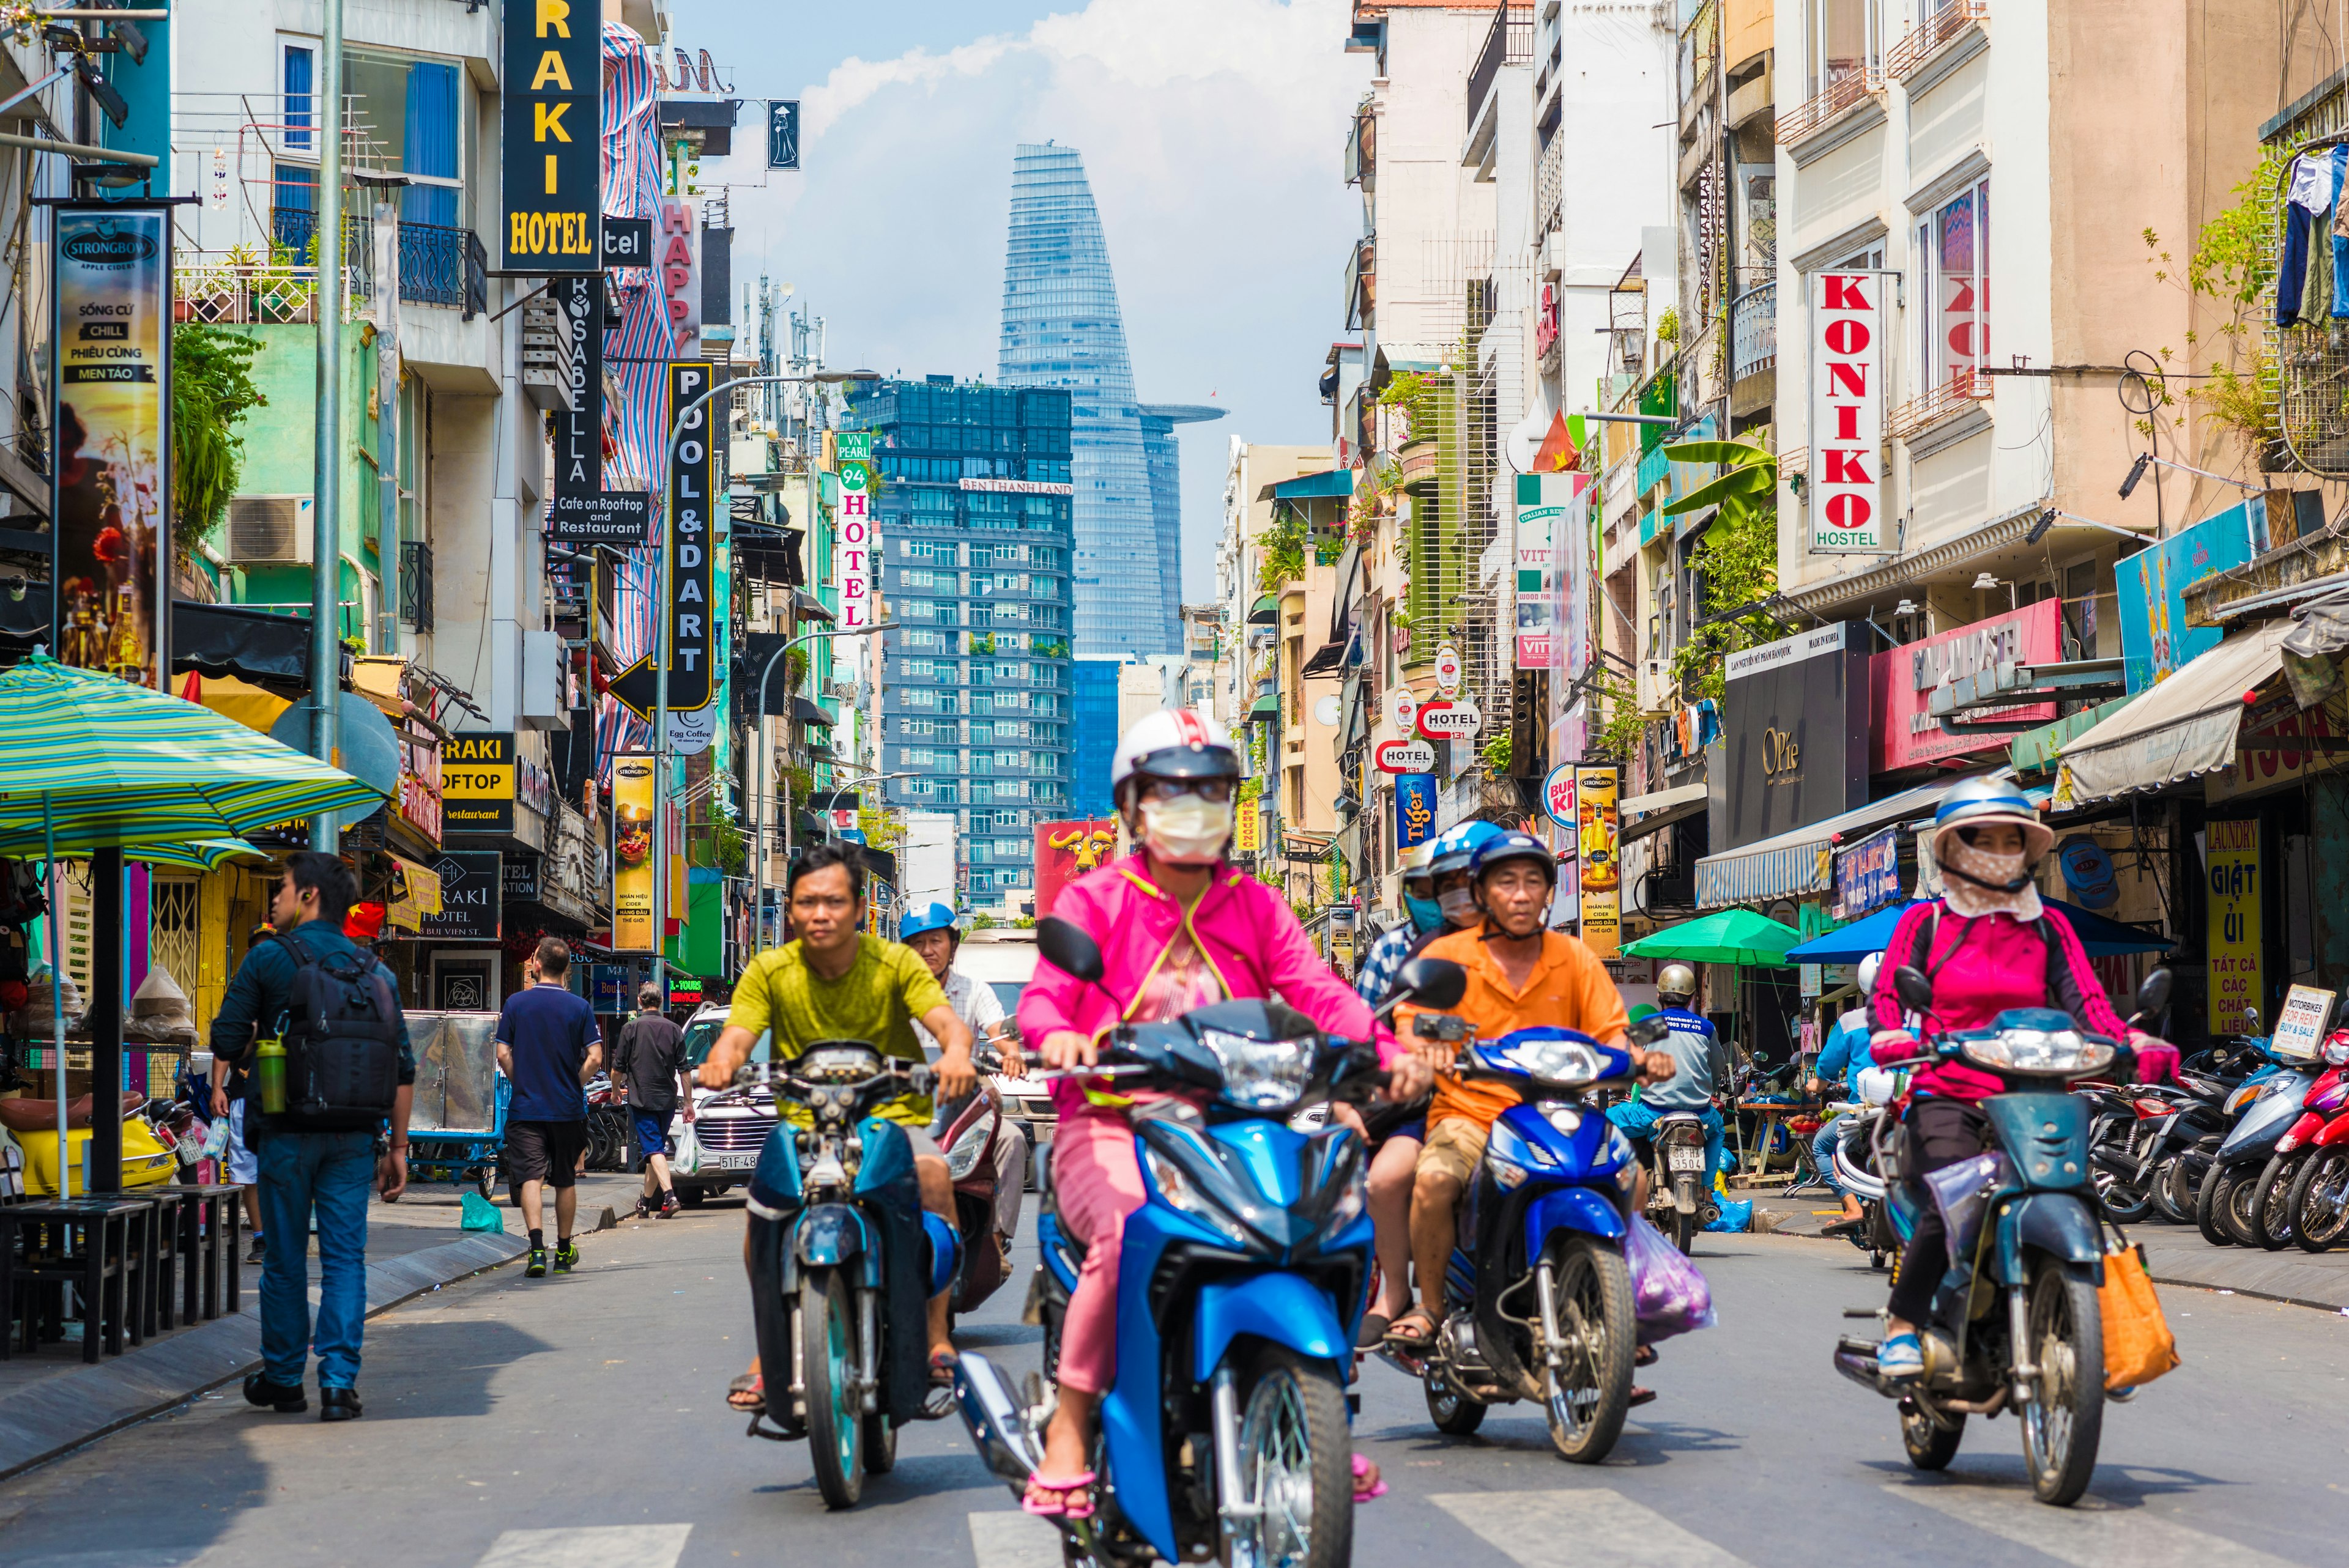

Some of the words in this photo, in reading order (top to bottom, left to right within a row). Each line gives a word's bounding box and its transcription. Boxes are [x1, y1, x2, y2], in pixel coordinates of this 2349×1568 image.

[510, 212, 592, 255] HOTEL
[71, 243, 148, 254] STRONGBOW
[79, 302, 113, 316] SỐNG
[116, 303, 135, 316] CỨ
[90, 326, 123, 336] CHILL
[71, 346, 104, 359] PHIÊU
[106, 345, 141, 358] CÙNG
[79, 369, 106, 379] MEN
[108, 366, 133, 379] TÁO
[1820, 275, 1875, 528] KONIKO
[847, 435, 861, 445] VN
[839, 447, 869, 457] PEARL
[843, 469, 865, 484] 94
[963, 479, 987, 490] BEN
[989, 481, 1034, 493] THANH
[1039, 483, 1072, 495] LAND
[559, 497, 583, 510] Cafe
[585, 500, 598, 510] on
[599, 497, 643, 514] Rooftop
[590, 512, 611, 522] and
[1521, 509, 1548, 522] ITALIAN
[559, 522, 642, 534] Restaurant
[1817, 532, 1877, 545] HOSTEL
[844, 495, 866, 626] HOTEL
[1809, 638, 1820, 649] MADE
[1820, 636, 1825, 645] IN
[1825, 632, 1839, 645] KOREA
[1429, 714, 1477, 724] HOTEL
[1387, 752, 1430, 760] HOTEL
[1553, 792, 1573, 815] KI
[447, 809, 499, 819] restaurant
[1405, 790, 1431, 841] Tiger
[2208, 820, 2258, 852] LAUNDRY
[2080, 862, 2093, 870] 333
[2211, 859, 2257, 903] GIẶT
[2212, 953, 2236, 972] TẤT
[2240, 953, 2257, 972] CẢ
[2222, 974, 2247, 992] CÁC
[2288, 999, 2323, 1013] MOTORBIKES
[2284, 1009, 2298, 1022] FOR
[2299, 1011, 2319, 1027] RENT
[2280, 1022, 2293, 1034] BUY
[2293, 1025, 2298, 1034] &
[2298, 1026, 2315, 1037] SALE
[722, 1156, 758, 1167] 51F-48
[1675, 1159, 1701, 1169] 3504
